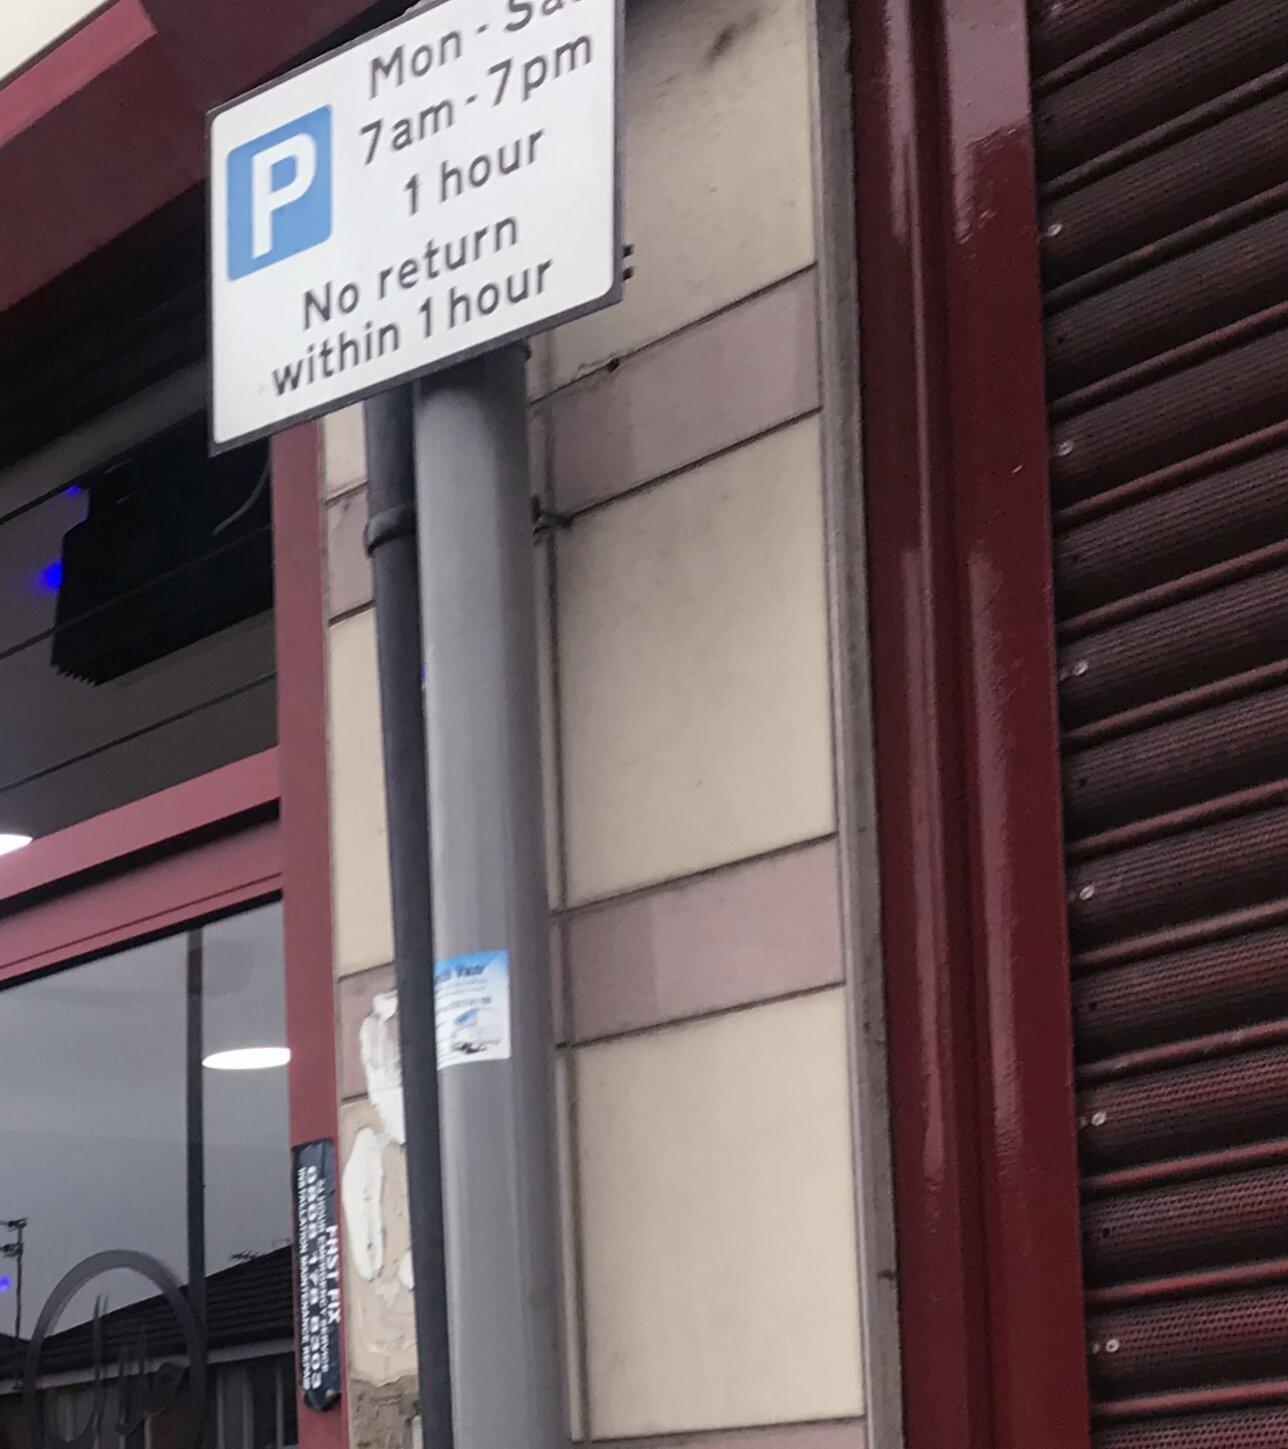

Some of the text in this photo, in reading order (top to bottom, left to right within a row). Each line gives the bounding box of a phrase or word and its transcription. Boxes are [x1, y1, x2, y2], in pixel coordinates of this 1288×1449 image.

[370, 26, 462, 101] Mon
[504, 0, 581, 32] Sa
[359, 96, 456, 167] 7am
[487, 34, 593, 108] 7pm
[251, 132, 317, 260] P
[404, 128, 545, 217] 1 hour
[303, 215, 519, 332] No return
[271, 258, 554, 397] within 1 hour
[317, 1195, 327, 1233] HOUR
[300, 1256, 311, 1345] MAINTENANCE
[318, 1235, 328, 1316] EMERGENCY
[326, 1287, 341, 1325] FIX
[319, 1318, 330, 1374] SERVICE
